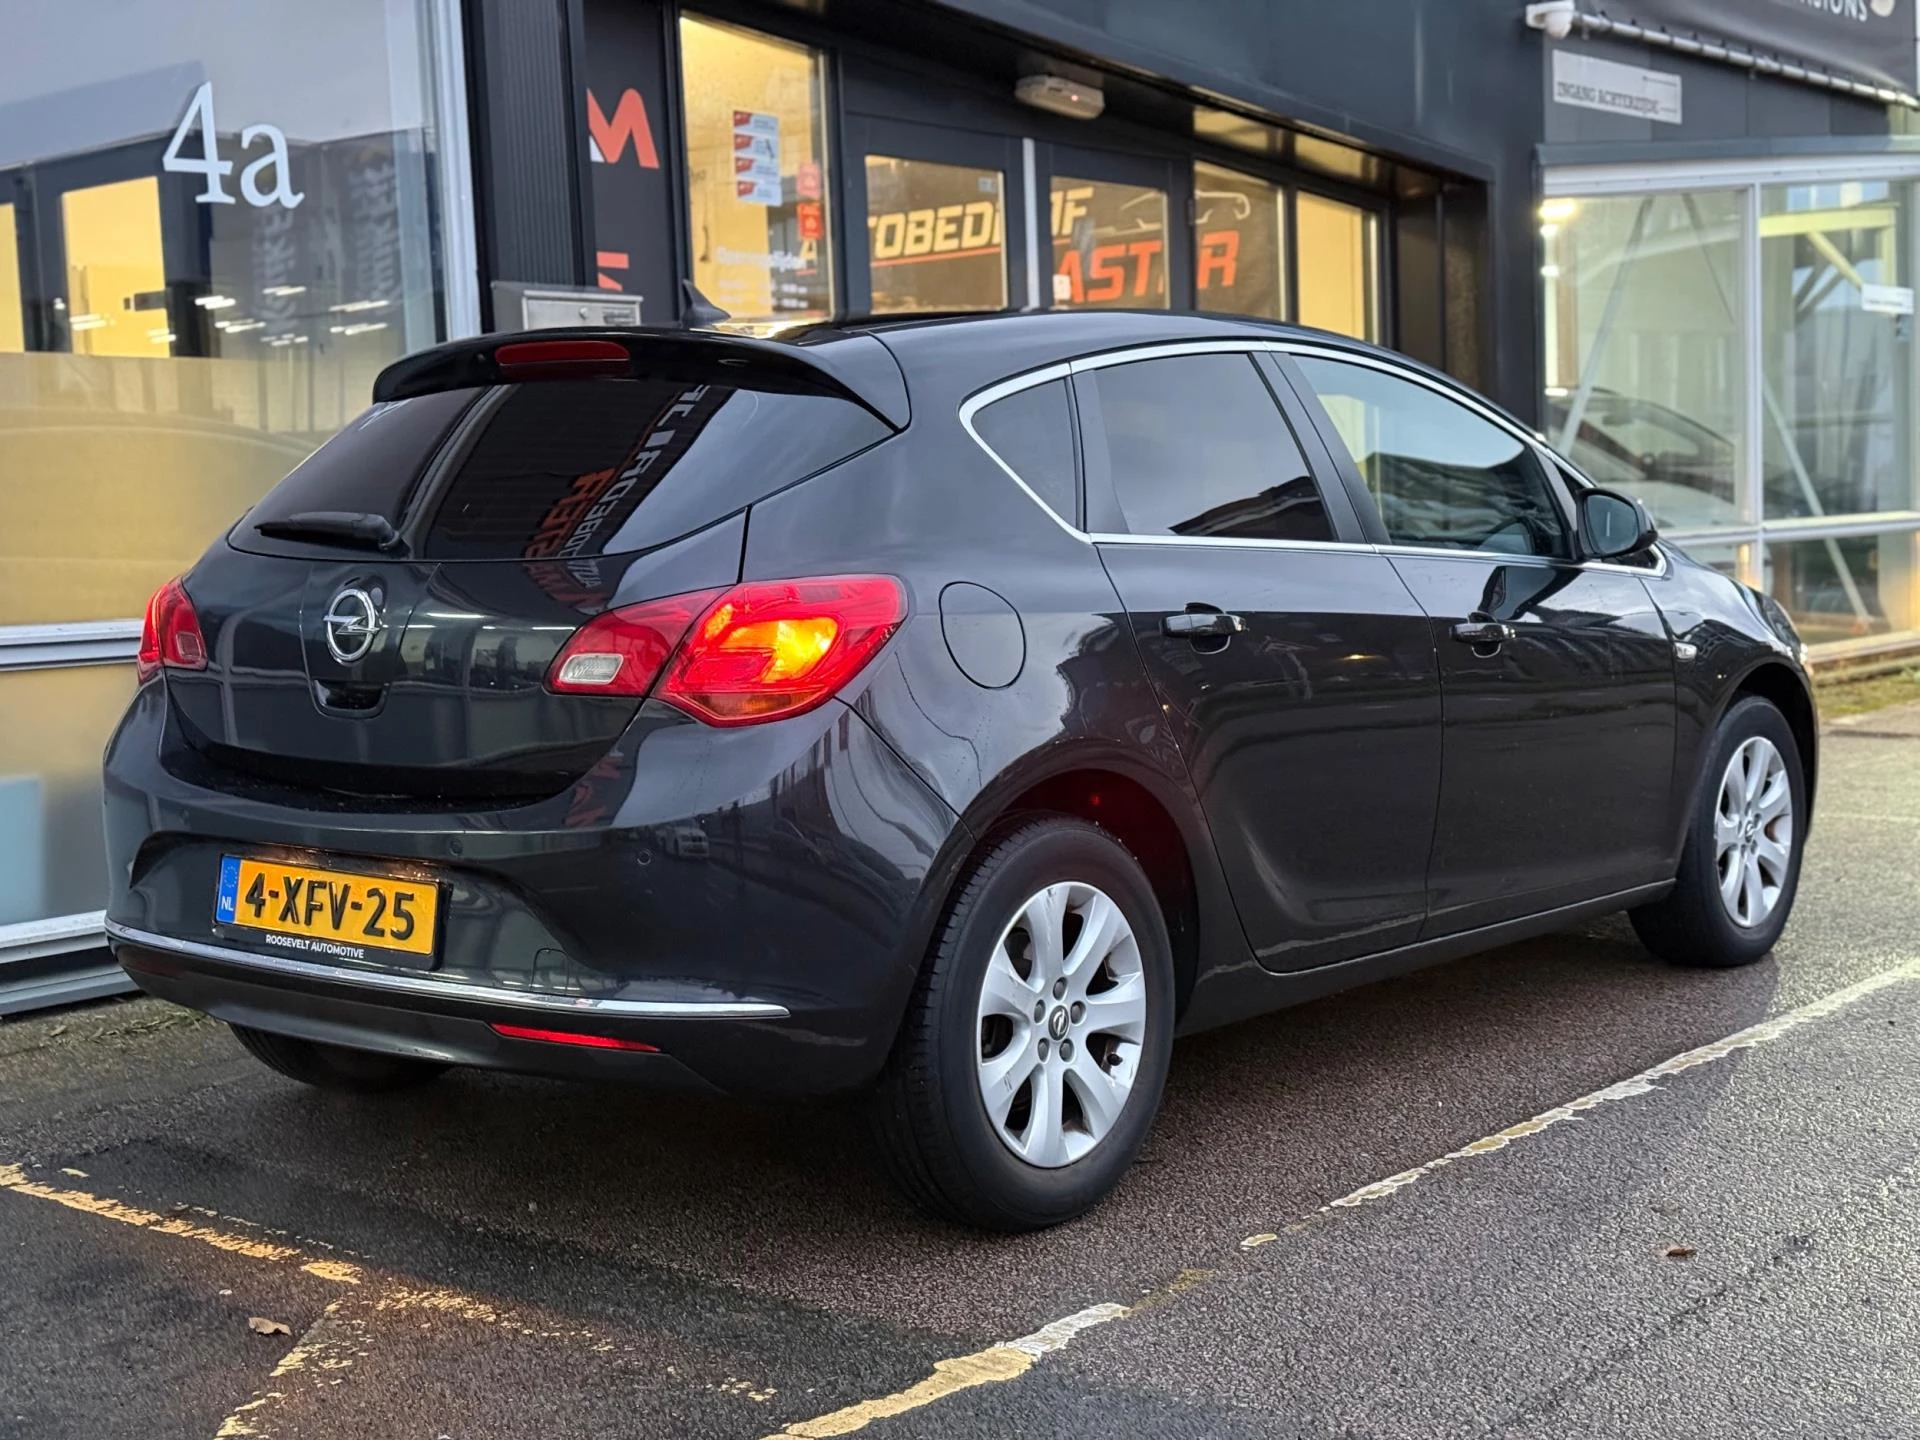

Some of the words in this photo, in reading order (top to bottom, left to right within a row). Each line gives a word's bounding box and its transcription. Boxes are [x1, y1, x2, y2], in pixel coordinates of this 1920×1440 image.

[162, 80, 305, 209] 4a
[221, 896, 234, 912] NL
[245, 872, 415, 941] 4-XFV-25
[265, 933, 310, 950] ROOSEVELT
[310, 941, 365, 959] AUTOMOTIVE
